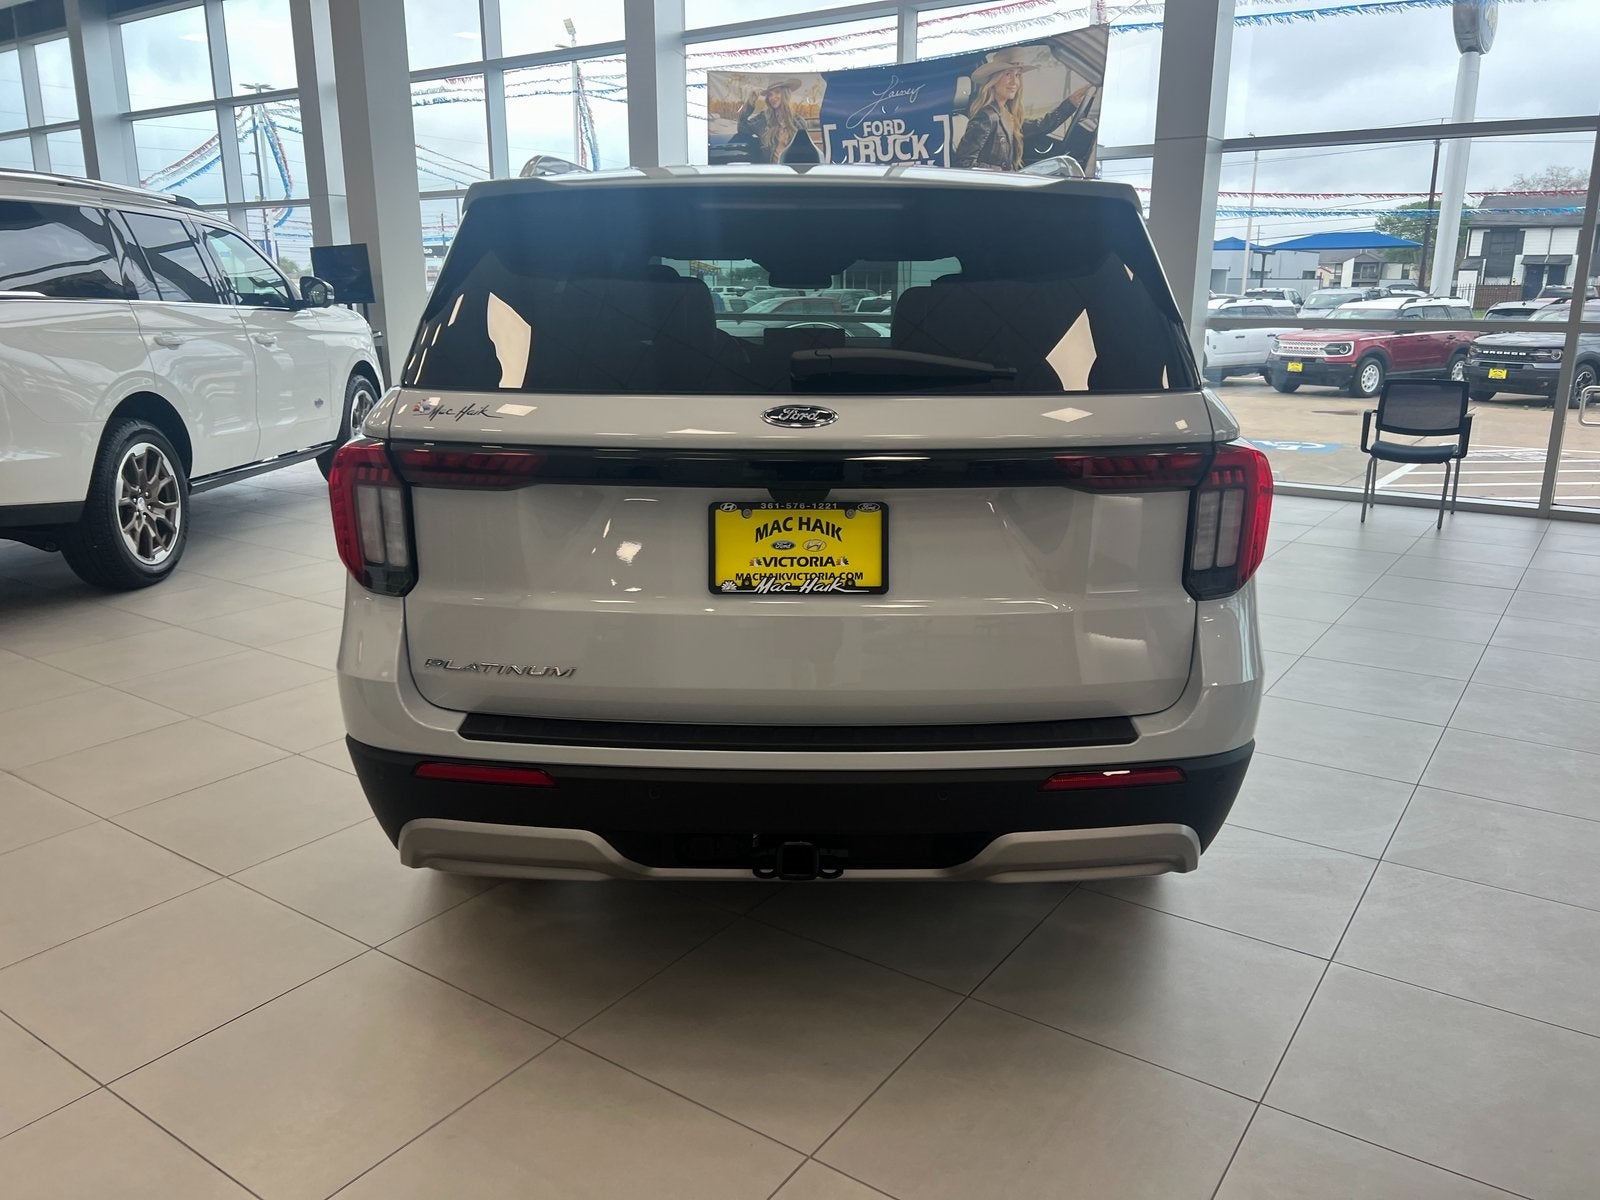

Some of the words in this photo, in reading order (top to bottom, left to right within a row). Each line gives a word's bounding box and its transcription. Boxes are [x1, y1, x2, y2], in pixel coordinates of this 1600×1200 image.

[863, 119, 905, 136] FORD
[842, 133, 929, 164] TRUCK
[454, 403, 503, 421] Haik
[778, 407, 820, 421] Ford
[755, 517, 793, 543] MAC
[798, 516, 842, 542] HAIK
[774, 541, 793, 549] Ford
[762, 556, 836, 568] VICTORIA
[753, 577, 798, 594] Mac
[799, 577, 869, 594] Haik
[425, 658, 577, 679] PLATINUM
